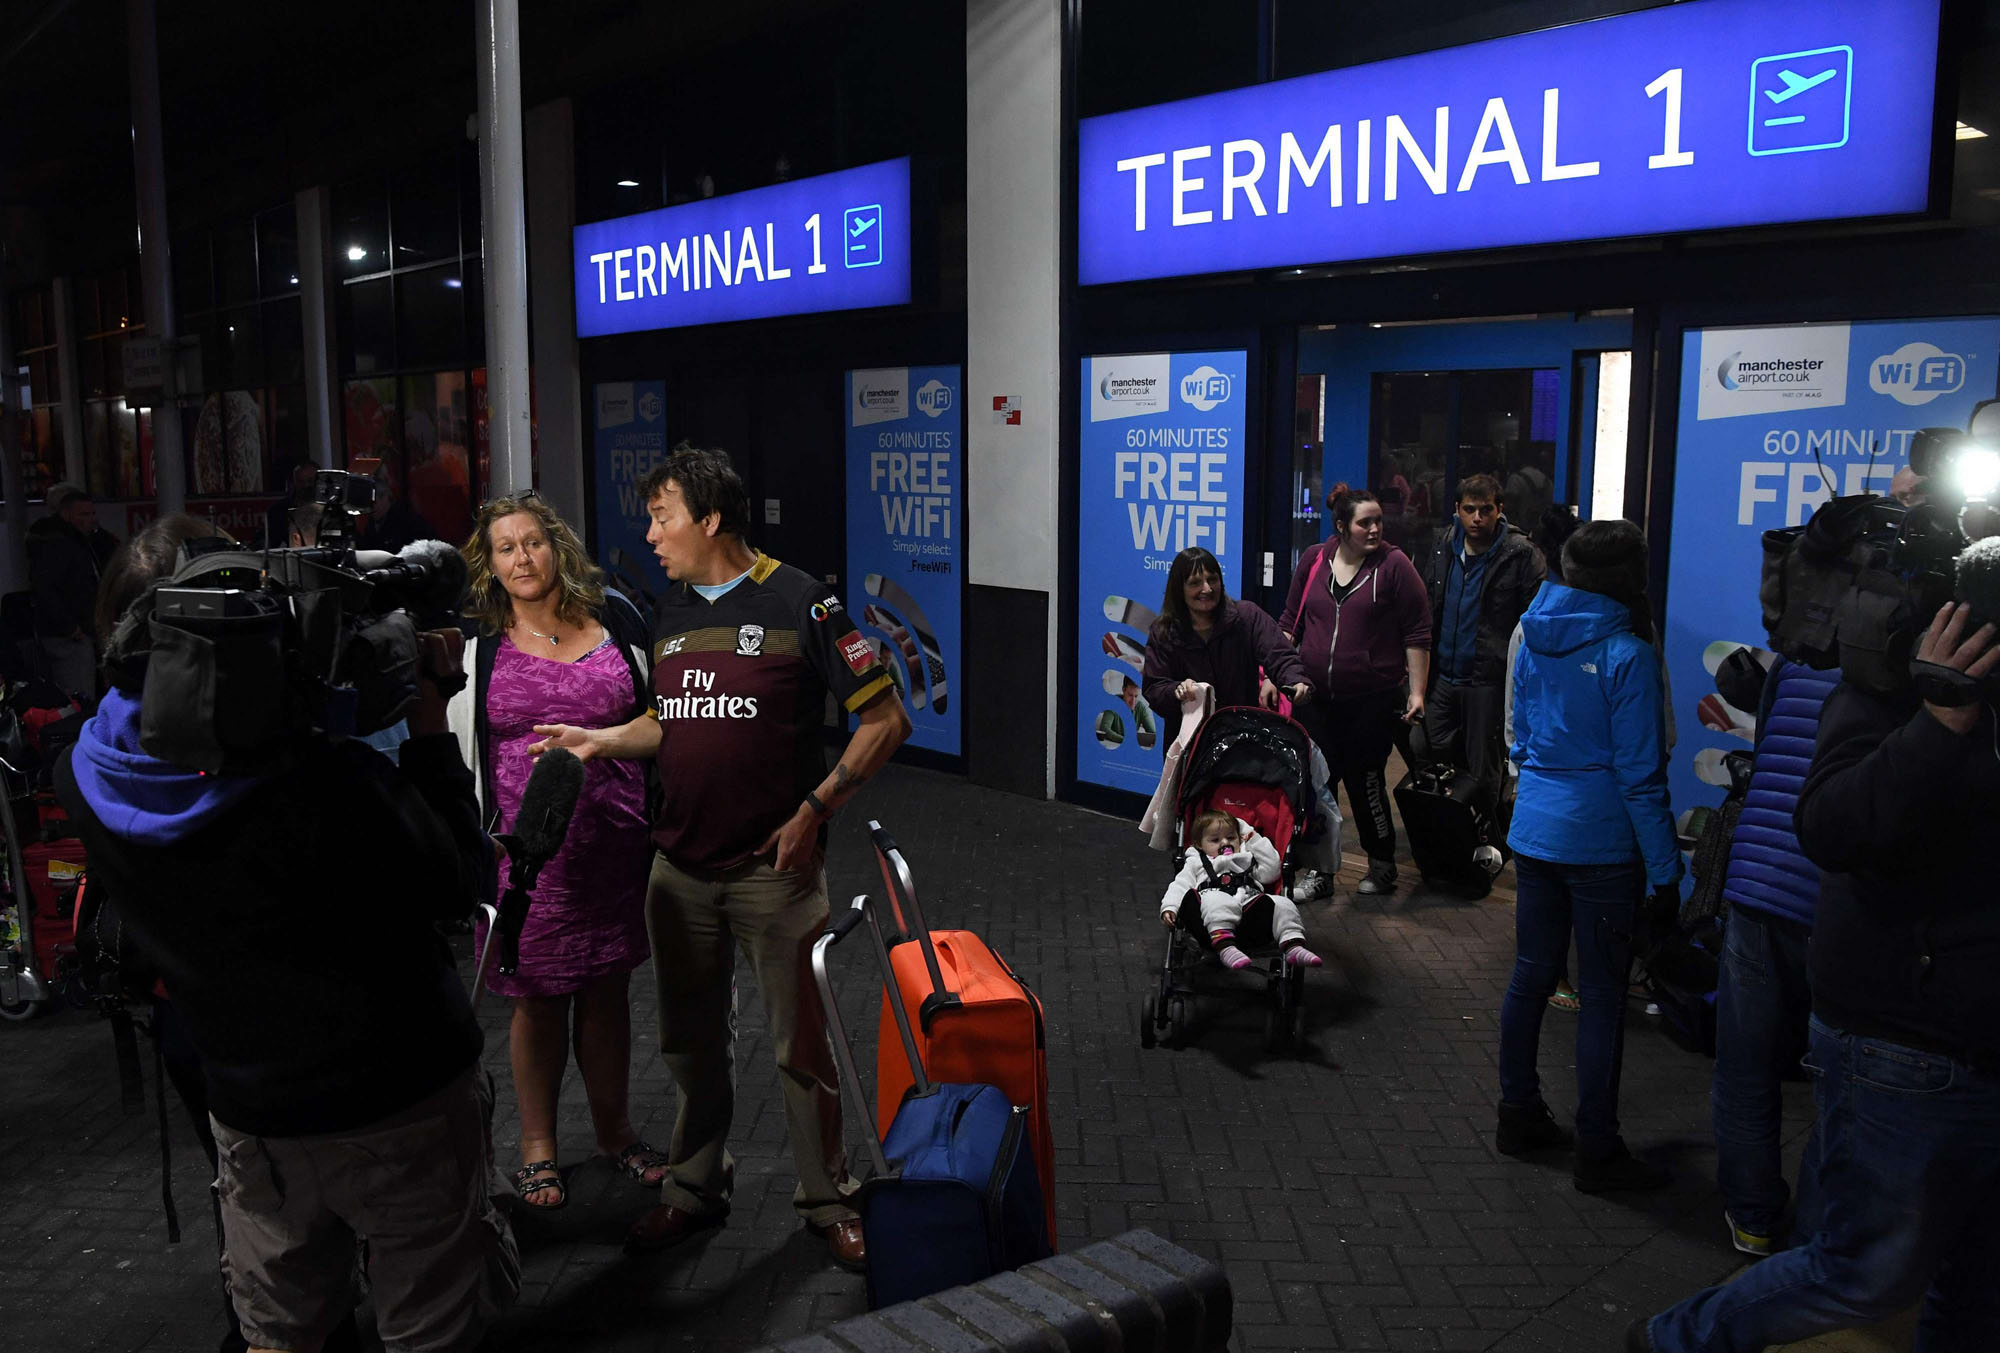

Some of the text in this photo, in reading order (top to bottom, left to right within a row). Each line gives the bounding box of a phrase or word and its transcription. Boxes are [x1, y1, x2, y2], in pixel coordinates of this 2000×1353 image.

[1116, 68, 1695, 232] TERMINAL 1
[590, 213, 827, 304] TERMINAL 1
[1738, 358, 1824, 372] manchester
[1111, 378, 1157, 387] manchester
[1737, 372, 1810, 385] airport.co.uk
[866, 388, 900, 397] manchester
[1111, 387, 1150, 396] airport.co.uk
[878, 432, 893, 449] 60
[1126, 428, 1147, 448] 60
[1763, 429, 1917, 457] 60 MINUT
[870, 452, 952, 494] FREE
[1114, 451, 1228, 503] FREE
[1737, 461, 1912, 527] FRE
[880, 494, 951, 539] WiFi
[1127, 502, 1227, 556] WiFi
[892, 539, 952, 556] Simply select:
[1143, 555, 1172, 575] Simp
[661, 636, 686, 656] ISC
[682, 668, 716, 692] Fly
